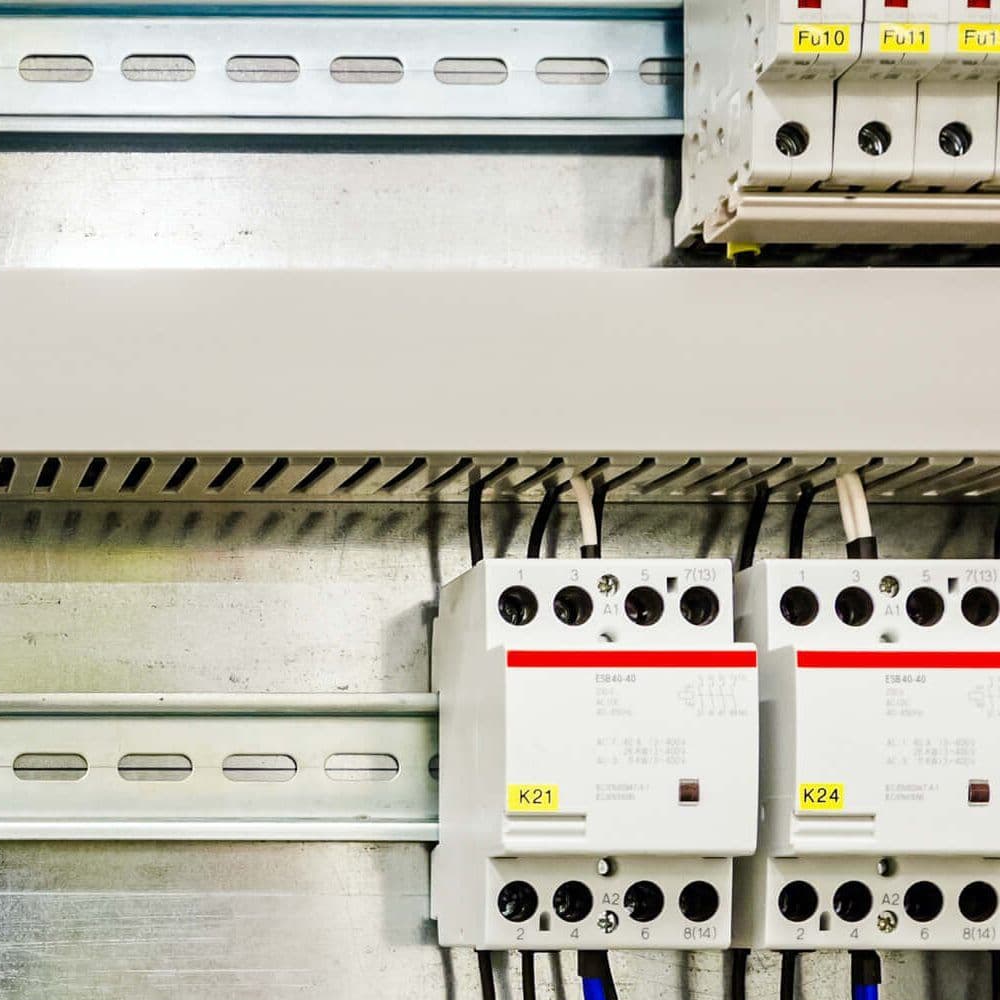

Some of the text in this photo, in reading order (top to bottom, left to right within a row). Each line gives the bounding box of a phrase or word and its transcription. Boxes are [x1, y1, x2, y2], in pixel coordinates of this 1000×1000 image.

[798, 30, 845, 46] Fu10
[883, 30, 926, 45] Fu11
[517, 569, 715, 582] 1 3 5 7(13)
[799, 570, 997, 583] 1 3 5 7(13)
[603, 604, 619, 615] A1
[885, 605, 900, 615] A1
[519, 789, 552, 803] K21
[804, 788, 839, 803] K24
[602, 893, 620, 905] A2
[882, 894, 900, 905] A2
[517, 927, 716, 940] 2 4 6 8(14)
[796, 927, 995, 940] 2 4 6 8(14)
